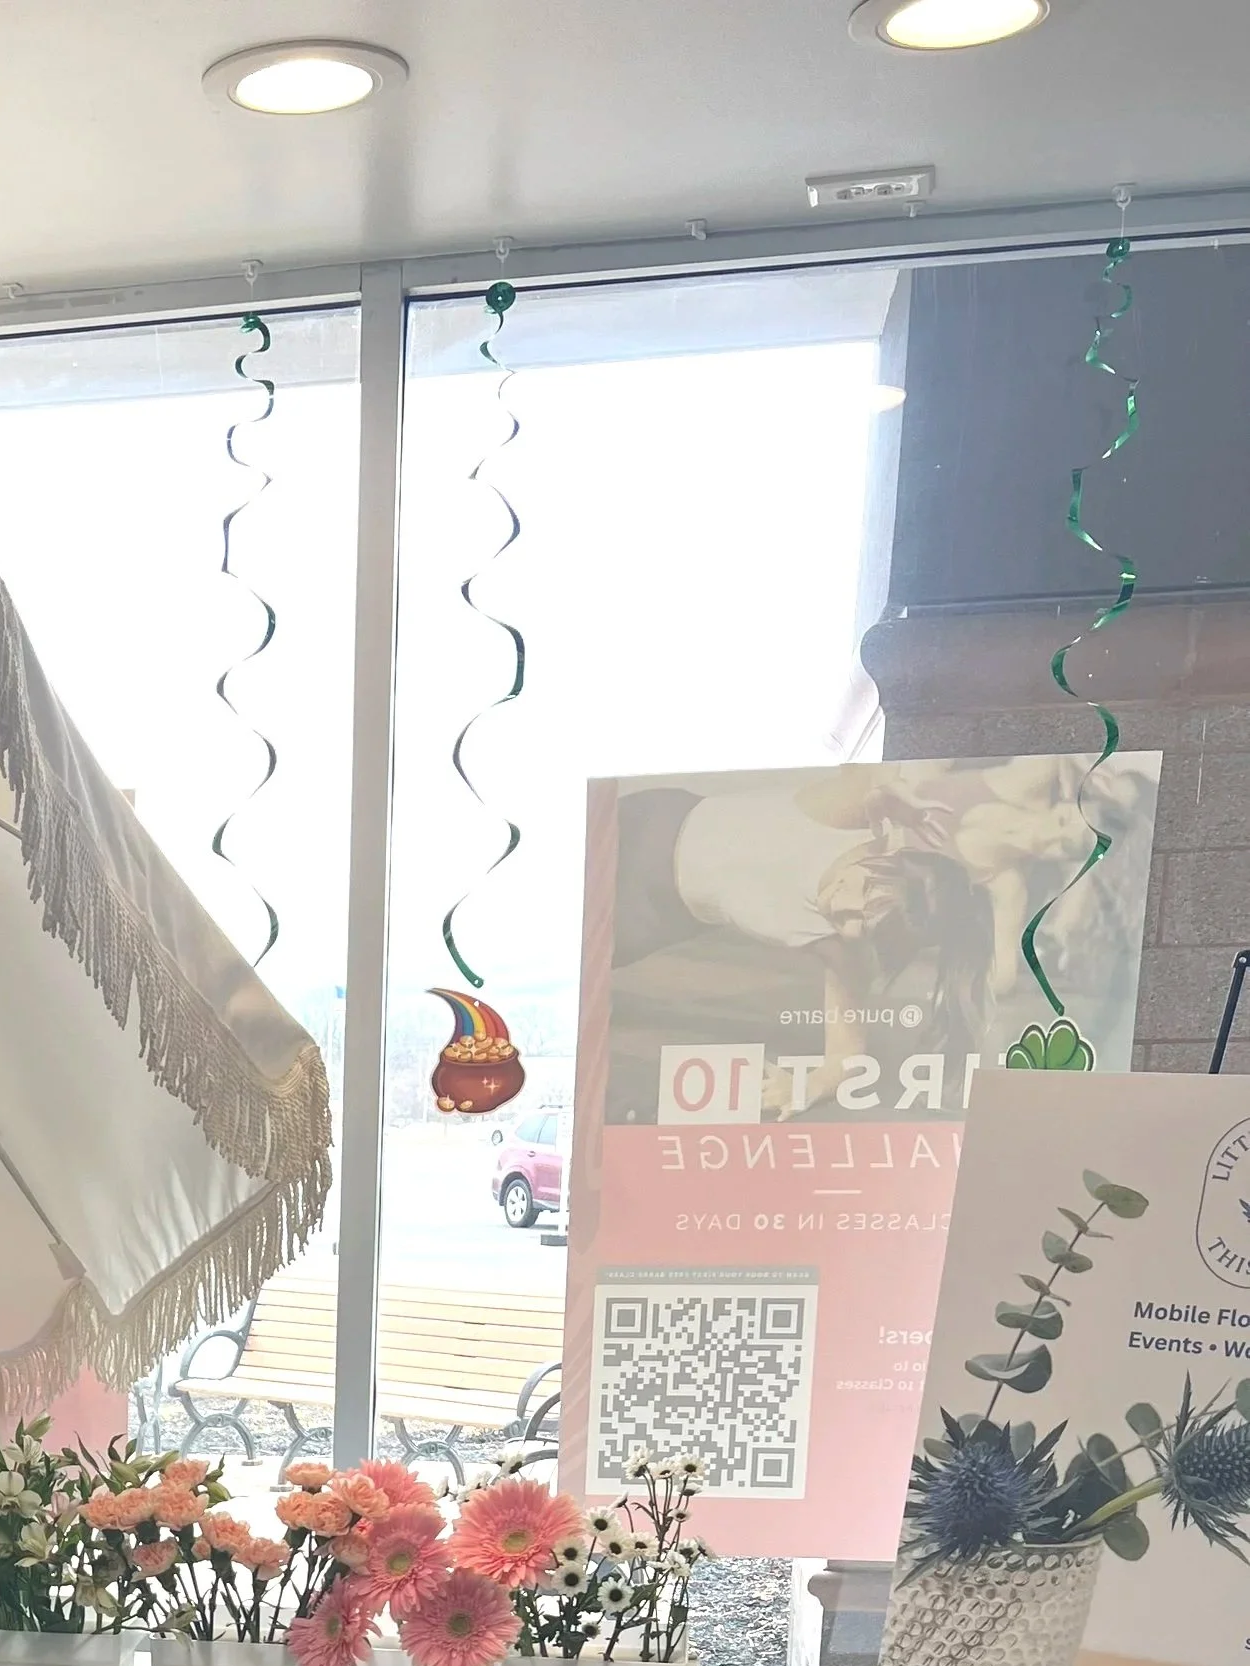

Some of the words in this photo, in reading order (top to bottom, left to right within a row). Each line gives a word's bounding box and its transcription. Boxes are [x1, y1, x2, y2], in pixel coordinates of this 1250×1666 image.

[1212, 1131, 1250, 1182] LITT
[1134, 1301, 1211, 1324] Mobile
[1128, 1331, 1203, 1354] Events
